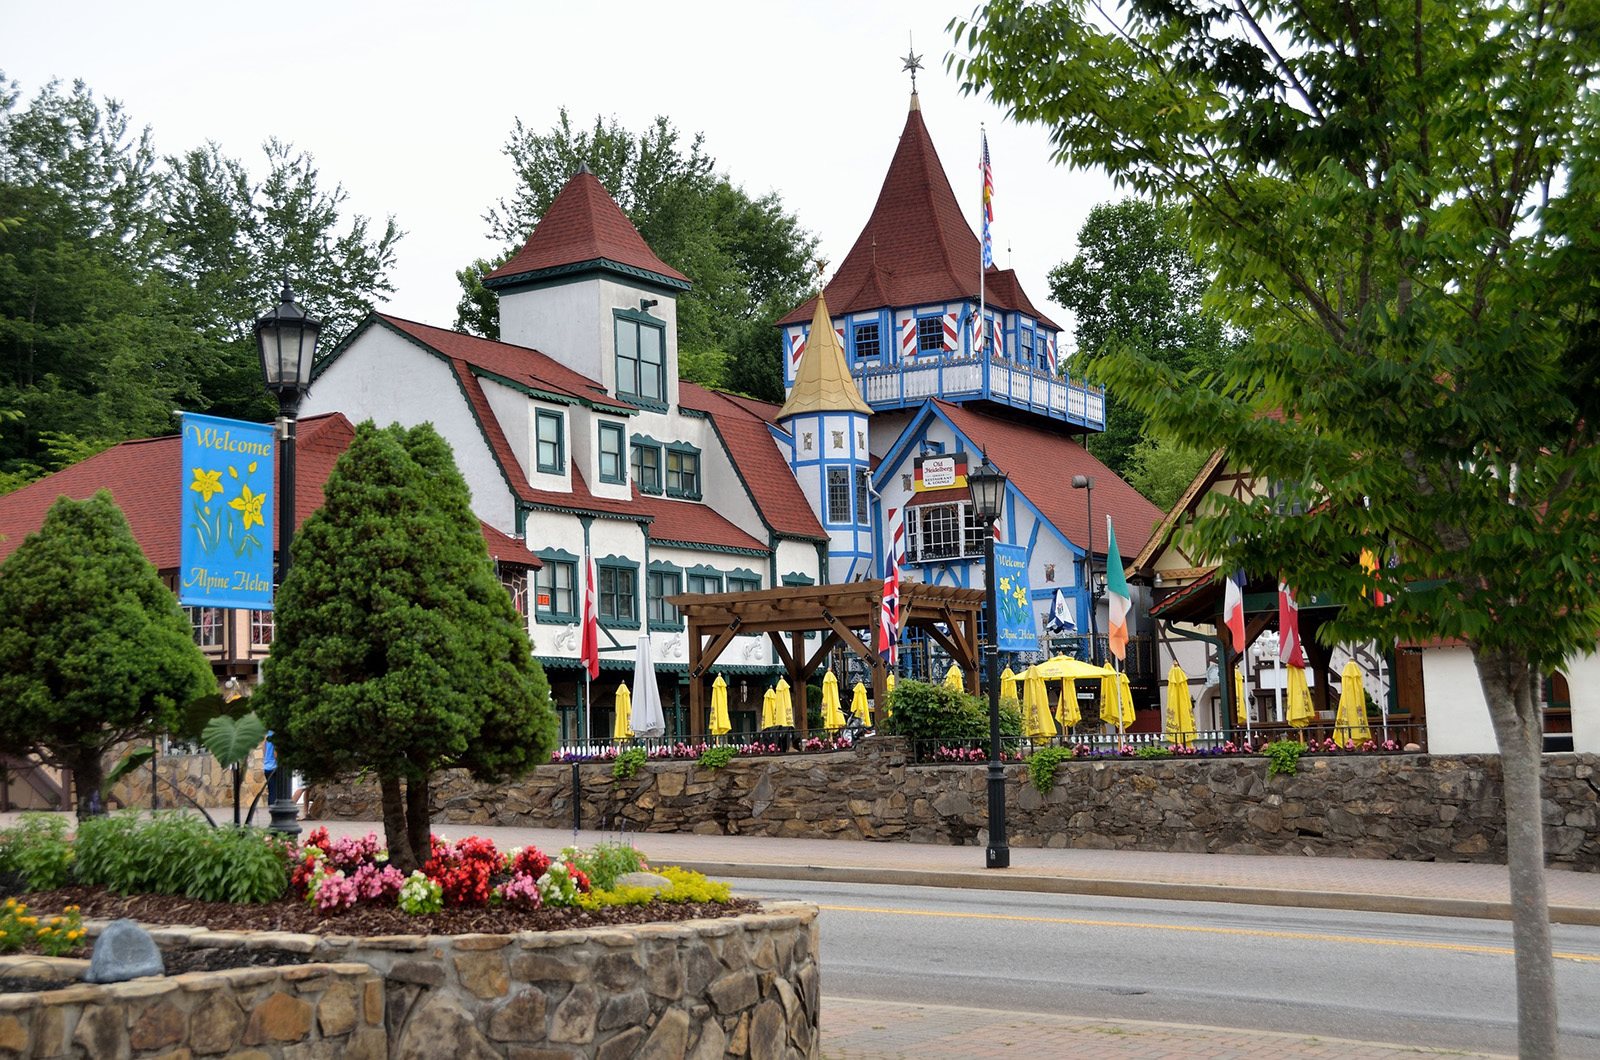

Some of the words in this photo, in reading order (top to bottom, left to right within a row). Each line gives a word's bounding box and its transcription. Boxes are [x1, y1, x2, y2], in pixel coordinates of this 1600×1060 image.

[185, 424, 271, 457] Welcome
[924, 466, 953, 474] Heidelberg
[997, 554, 1025, 569] Welcome
[183, 567, 230, 594] Alpine
[231, 570, 270, 592] Helen
[1018, 628, 1035, 640] Helen
